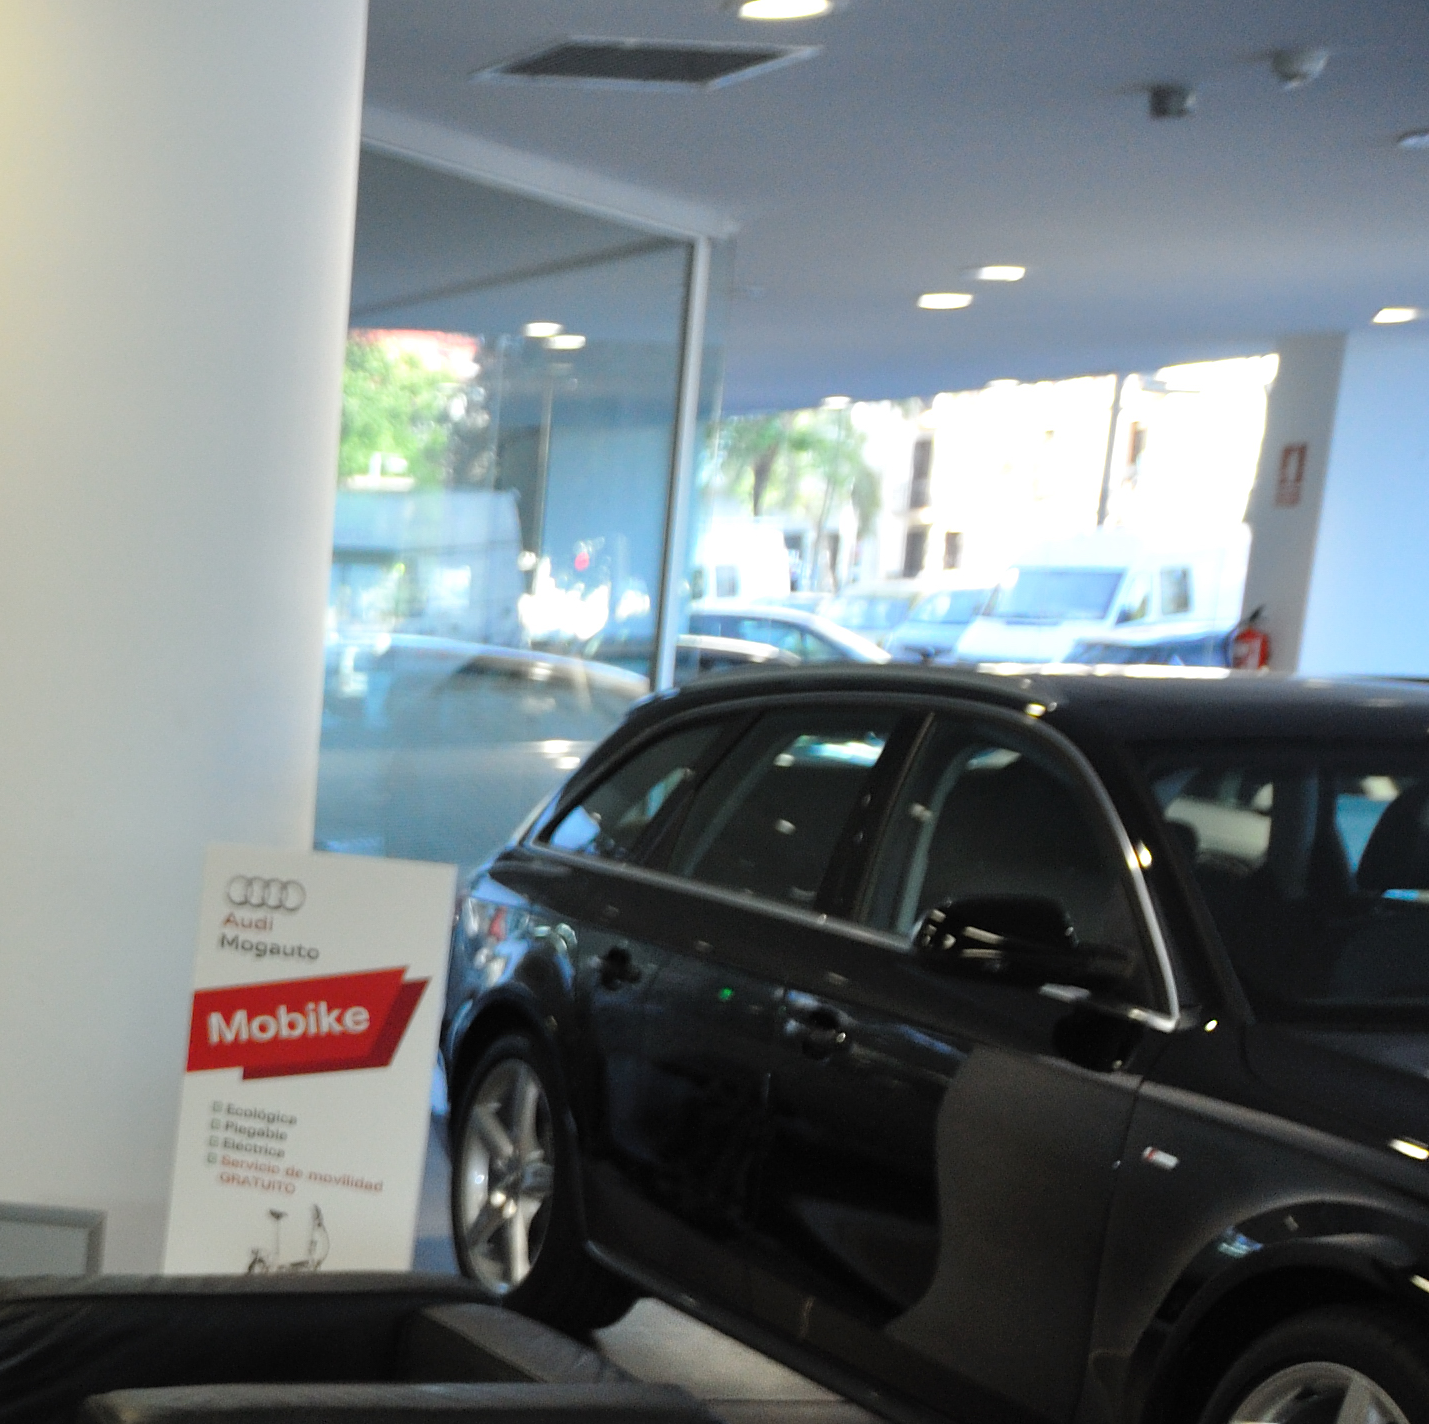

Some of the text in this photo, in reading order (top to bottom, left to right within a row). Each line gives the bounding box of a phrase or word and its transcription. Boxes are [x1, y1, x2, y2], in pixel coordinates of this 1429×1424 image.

[221, 911, 275, 933] Audi
[219, 932, 321, 962] Mogauto
[207, 1001, 371, 1047] Mobike
[224, 1120, 288, 1141] Plegable
[219, 1171, 296, 1195] GRATUITO
[221, 1154, 384, 1193] Servicio de movilidad
